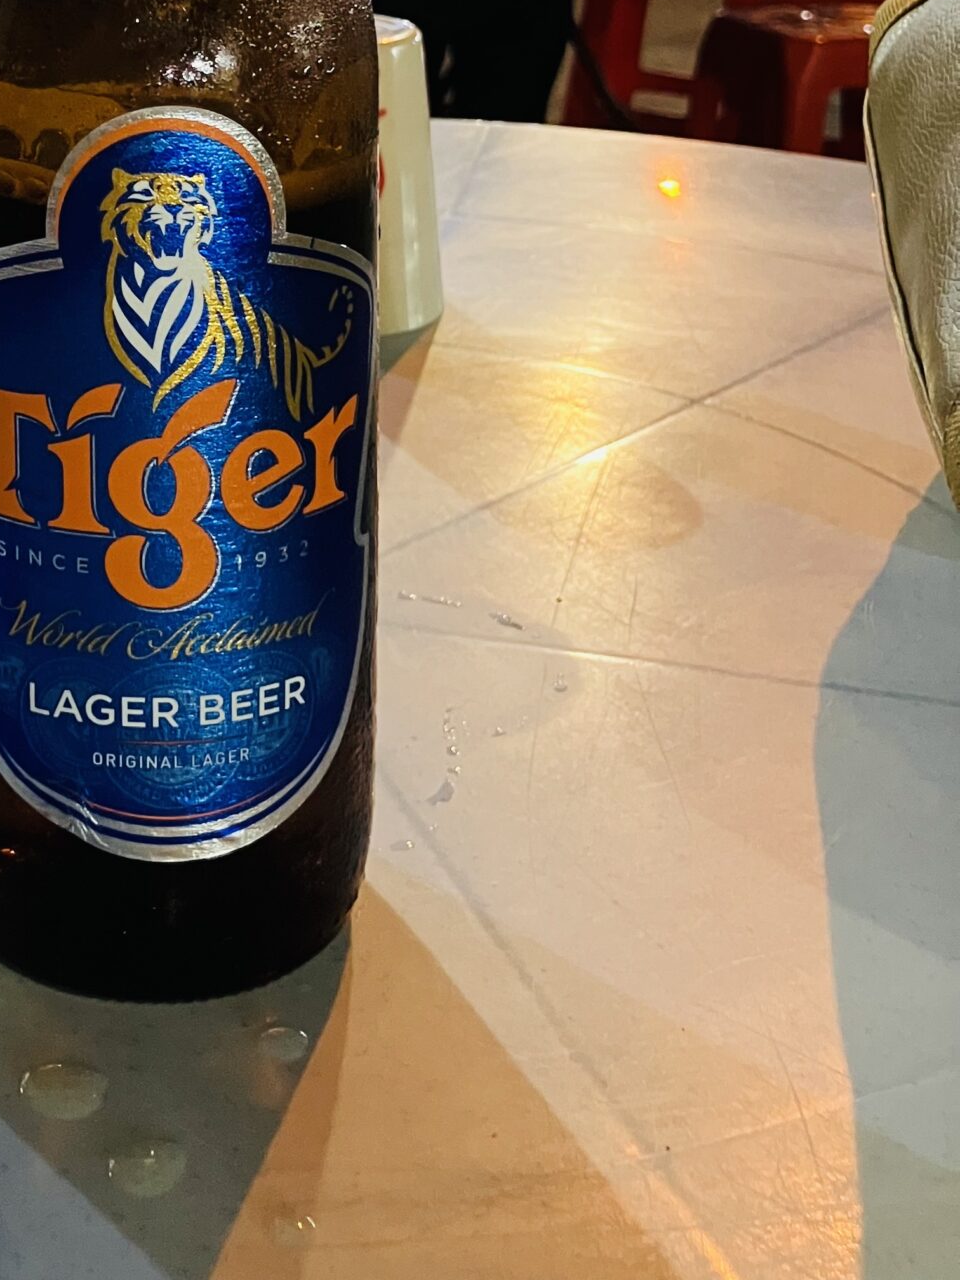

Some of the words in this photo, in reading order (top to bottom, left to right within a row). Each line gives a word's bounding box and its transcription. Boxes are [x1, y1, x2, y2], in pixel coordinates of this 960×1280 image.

[234, 541, 310, 574] 1932
[127, 589, 334, 661] Acclaimed
[27, 681, 180, 729] LAGER
[199, 674, 307, 727] BEER
[91, 750, 184, 770] ORIGINAL
[190, 747, 251, 769] LAGER
